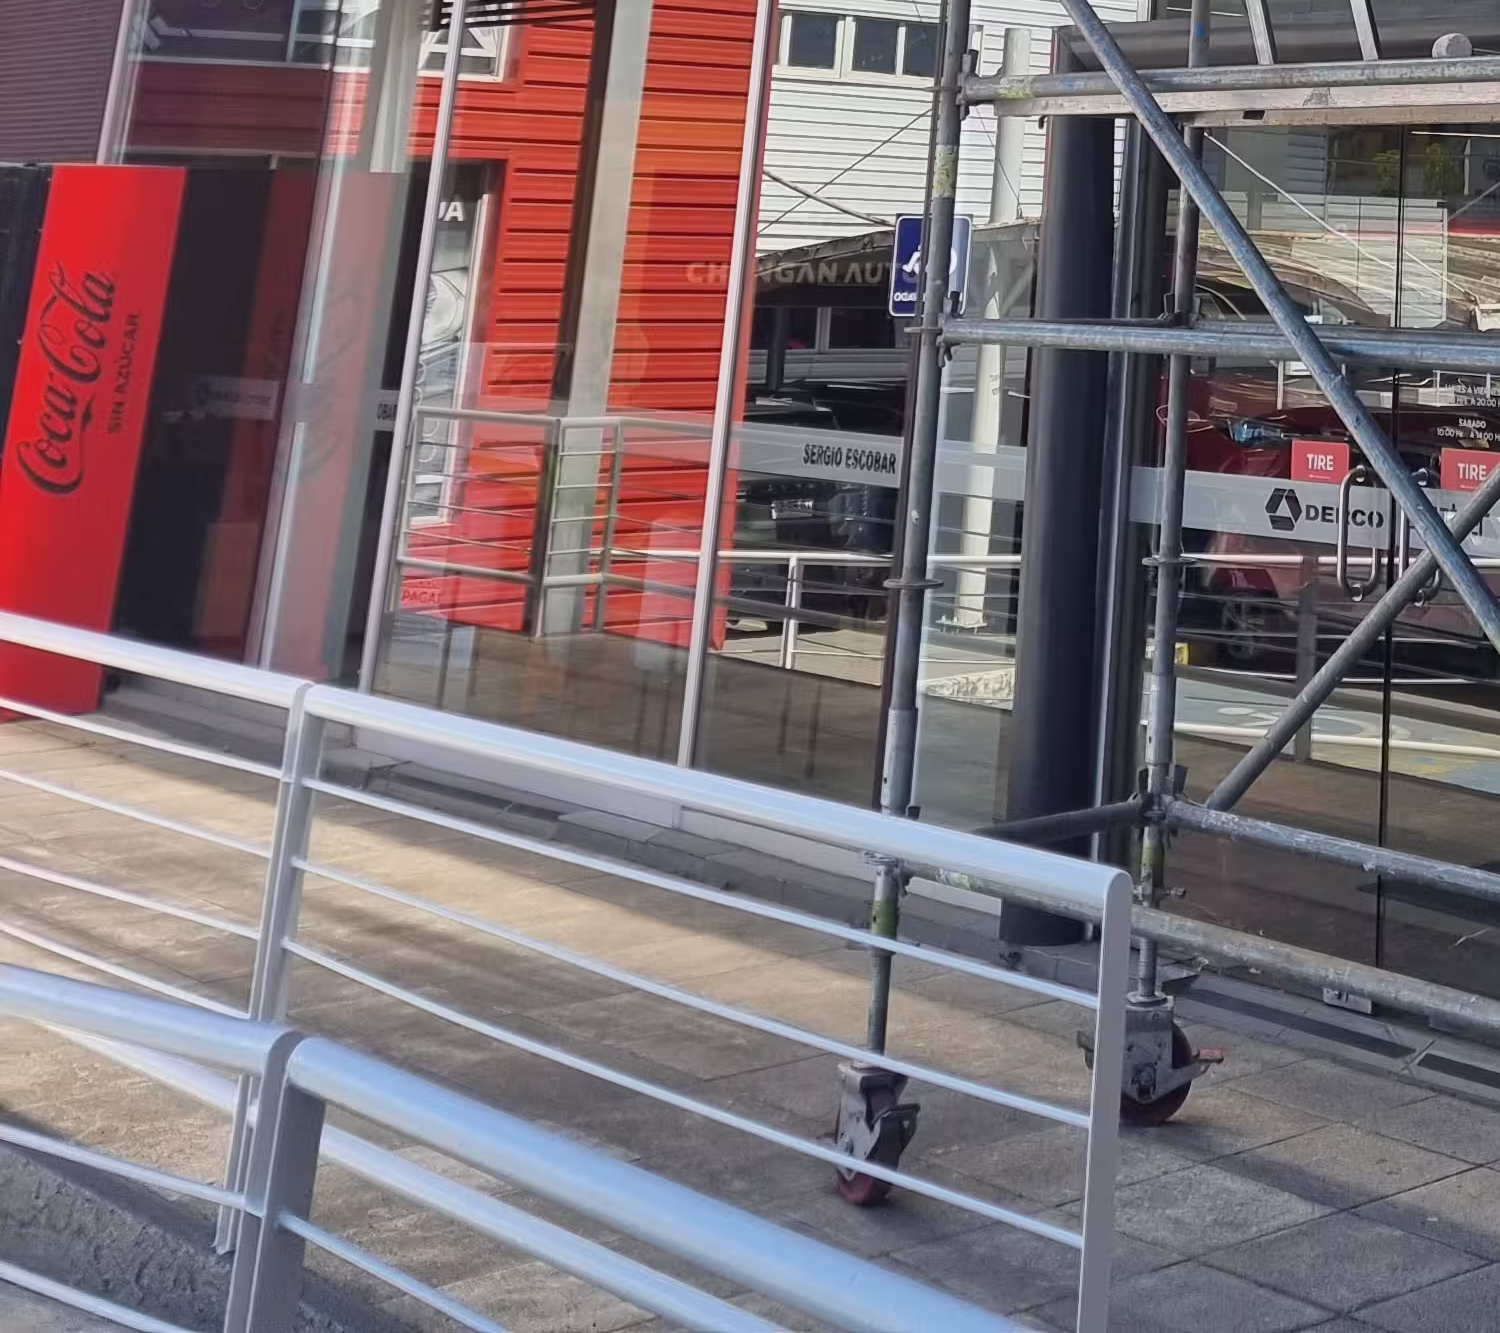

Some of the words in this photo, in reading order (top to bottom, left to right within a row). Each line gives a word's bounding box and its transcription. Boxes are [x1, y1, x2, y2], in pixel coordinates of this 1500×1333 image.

[685, 260, 843, 286] CHNGAN
[803, 443, 842, 468] SERGIO
[845, 448, 897, 474] ESCOBAR
[1306, 453, 1334, 471] TIRE
[1457, 463, 1487, 481] TIRE
[1305, 503, 1384, 529] DECO
